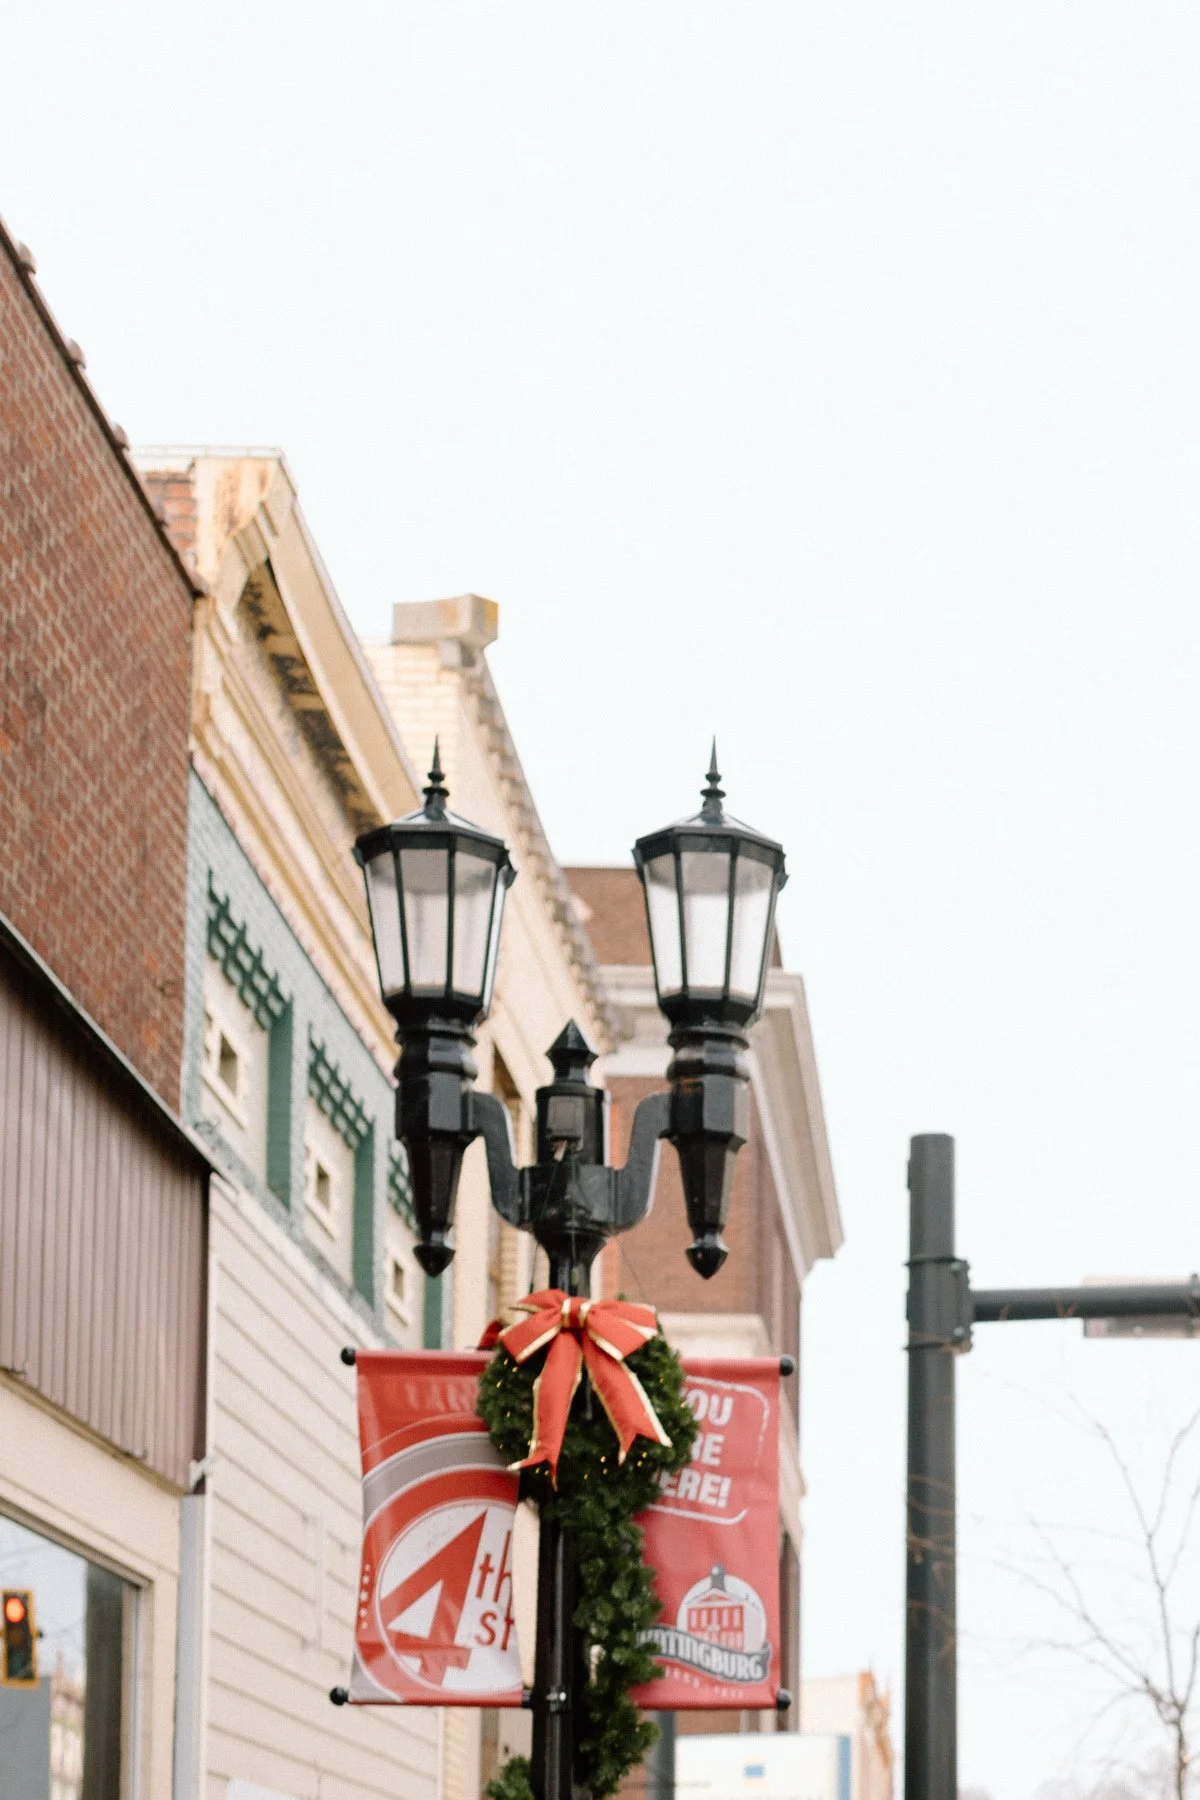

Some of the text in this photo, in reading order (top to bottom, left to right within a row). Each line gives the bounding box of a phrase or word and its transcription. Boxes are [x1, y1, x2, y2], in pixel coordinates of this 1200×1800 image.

[680, 1388, 733, 1427] OU
[652, 1467, 731, 1508] ERE!
[635, 1628, 763, 1679] NTINGBURG
